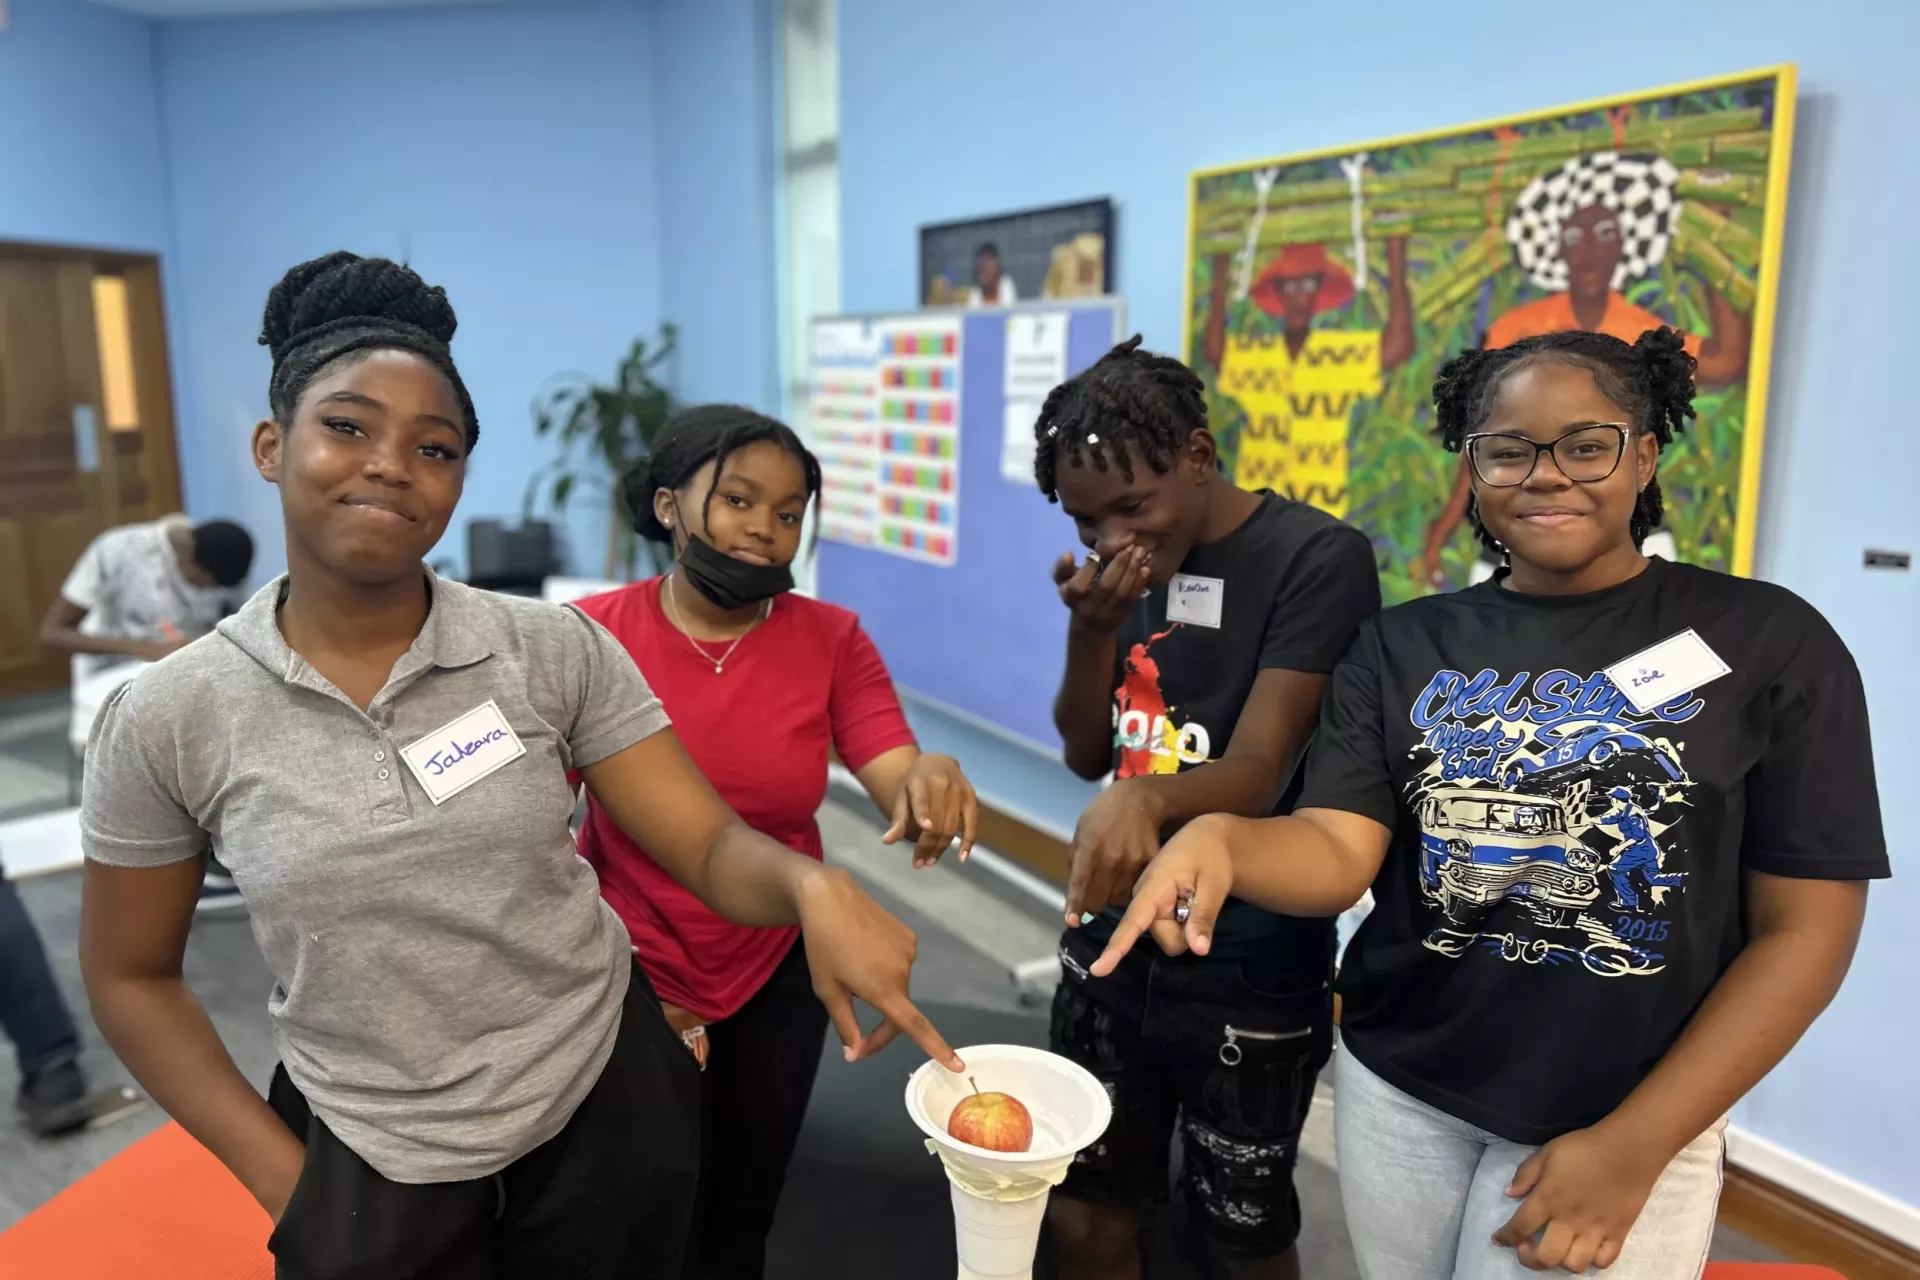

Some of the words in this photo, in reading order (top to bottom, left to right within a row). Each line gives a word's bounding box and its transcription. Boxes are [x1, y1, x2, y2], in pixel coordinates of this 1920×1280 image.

[1410, 668, 1531, 729] Old
[1528, 668, 1705, 743] Stye
[1112, 703, 1210, 763] OLO
[1441, 747, 1501, 783] End
[1557, 743, 1573, 762] 15
[1614, 915, 1672, 941] 2015
